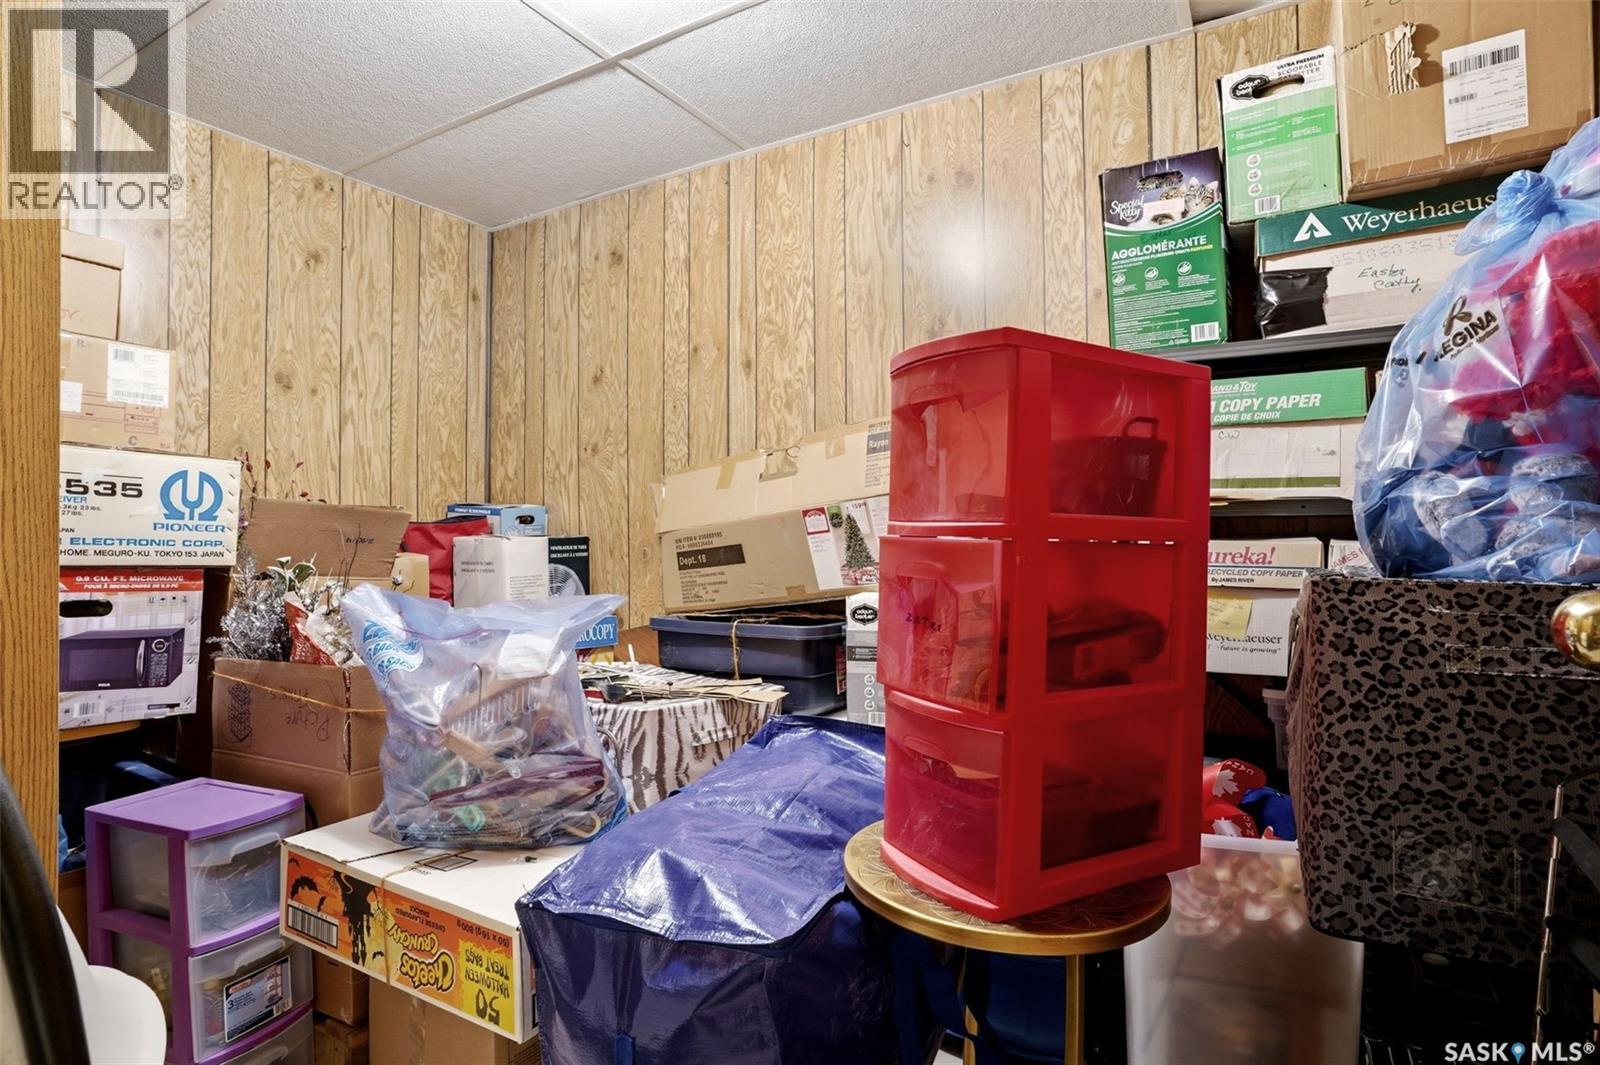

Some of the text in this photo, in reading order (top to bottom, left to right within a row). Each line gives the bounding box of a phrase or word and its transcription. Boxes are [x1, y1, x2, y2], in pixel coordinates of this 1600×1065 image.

[1277, 60, 1322, 77] SCOOPABLE
[1296, 53, 1324, 65] PREMIUM
[1110, 195, 1144, 214] Special
[1112, 235, 1207, 260] AGGLOMÉRANTE
[1219, 397, 1263, 414] COPY
[1265, 393, 1322, 410] PAPER
[1214, 411, 1281, 423] COPIE DE CHOIX
[153, 523, 225, 532] PIONEER
[70, 537, 225, 548] ELECTRONIC CORP.
[679, 556, 697, 567] Dept.
[1250, 569, 1274, 577] COPY
[1275, 570, 1304, 578] PAPER
[395, 908, 446, 933] CHEESE FLAVOURED
[408, 905, 430, 918] SNACKS
[387, 924, 439, 955] CRUNCHY
[399, 952, 454, 992] Cheetos
[465, 948, 509, 981] TREAT BAGS
[464, 966, 510, 998] HALLOWEEN
[475, 989, 501, 1026] 50
